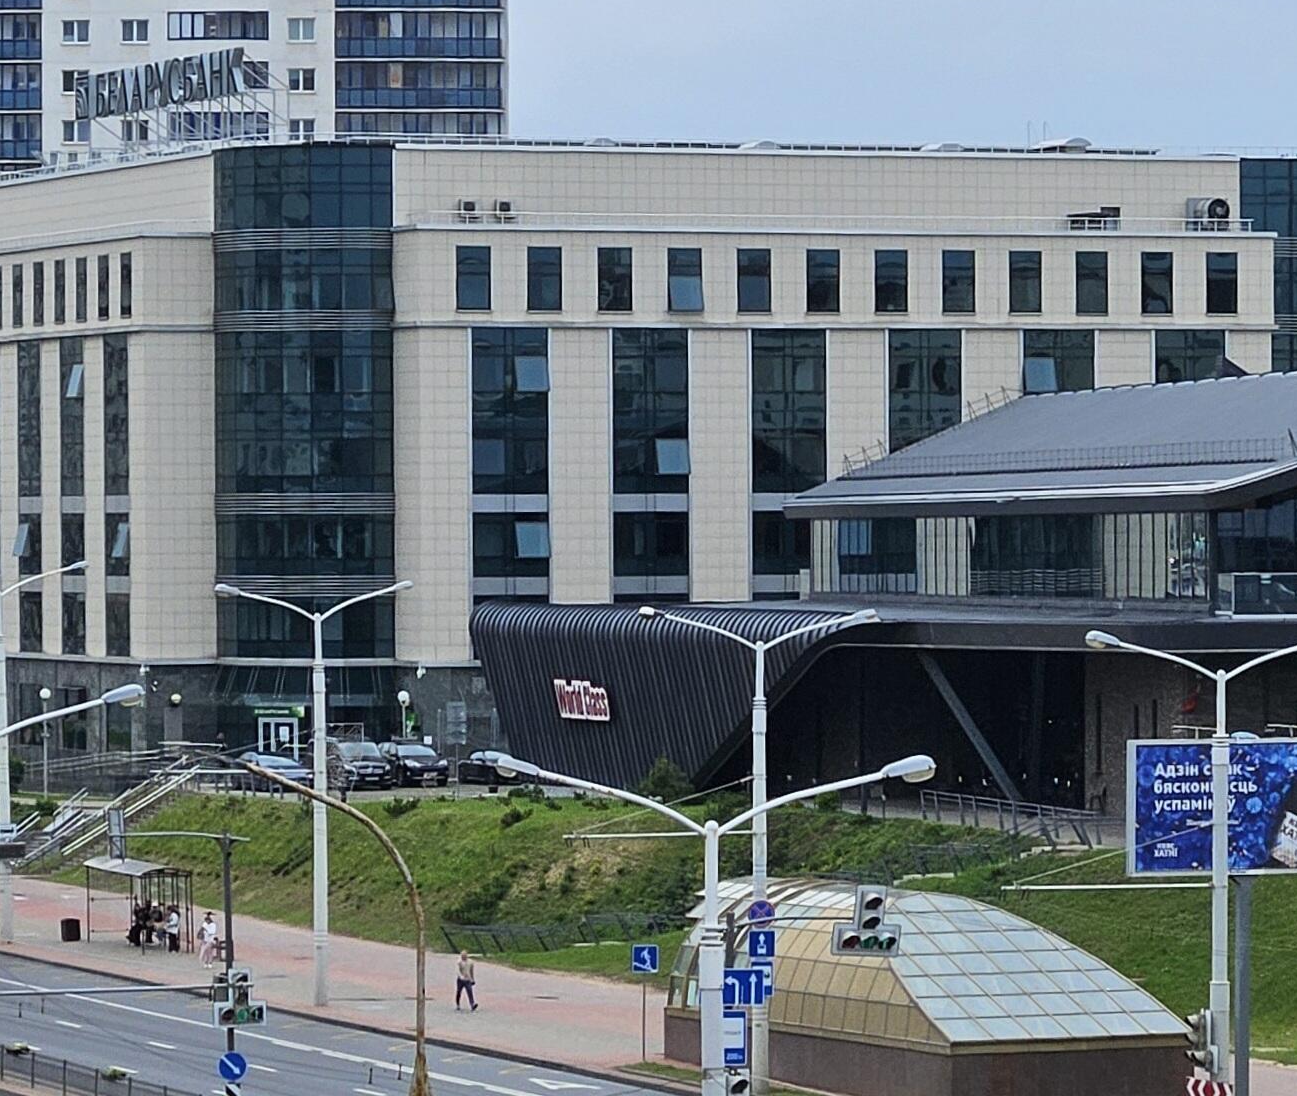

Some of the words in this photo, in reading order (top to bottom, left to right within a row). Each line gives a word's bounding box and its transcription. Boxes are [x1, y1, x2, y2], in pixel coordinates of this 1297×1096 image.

[96, 47, 244, 117] БЕЛАРУСБАНК
[555, 681, 584, 717] World
[582, 682, 609, 719] Class
[1154, 762, 1199, 779] Адзін
[1203, 764, 1243, 776] ск
[1154, 779, 1258, 794] бясконсць
[1154, 794, 1236, 815] успамінў
